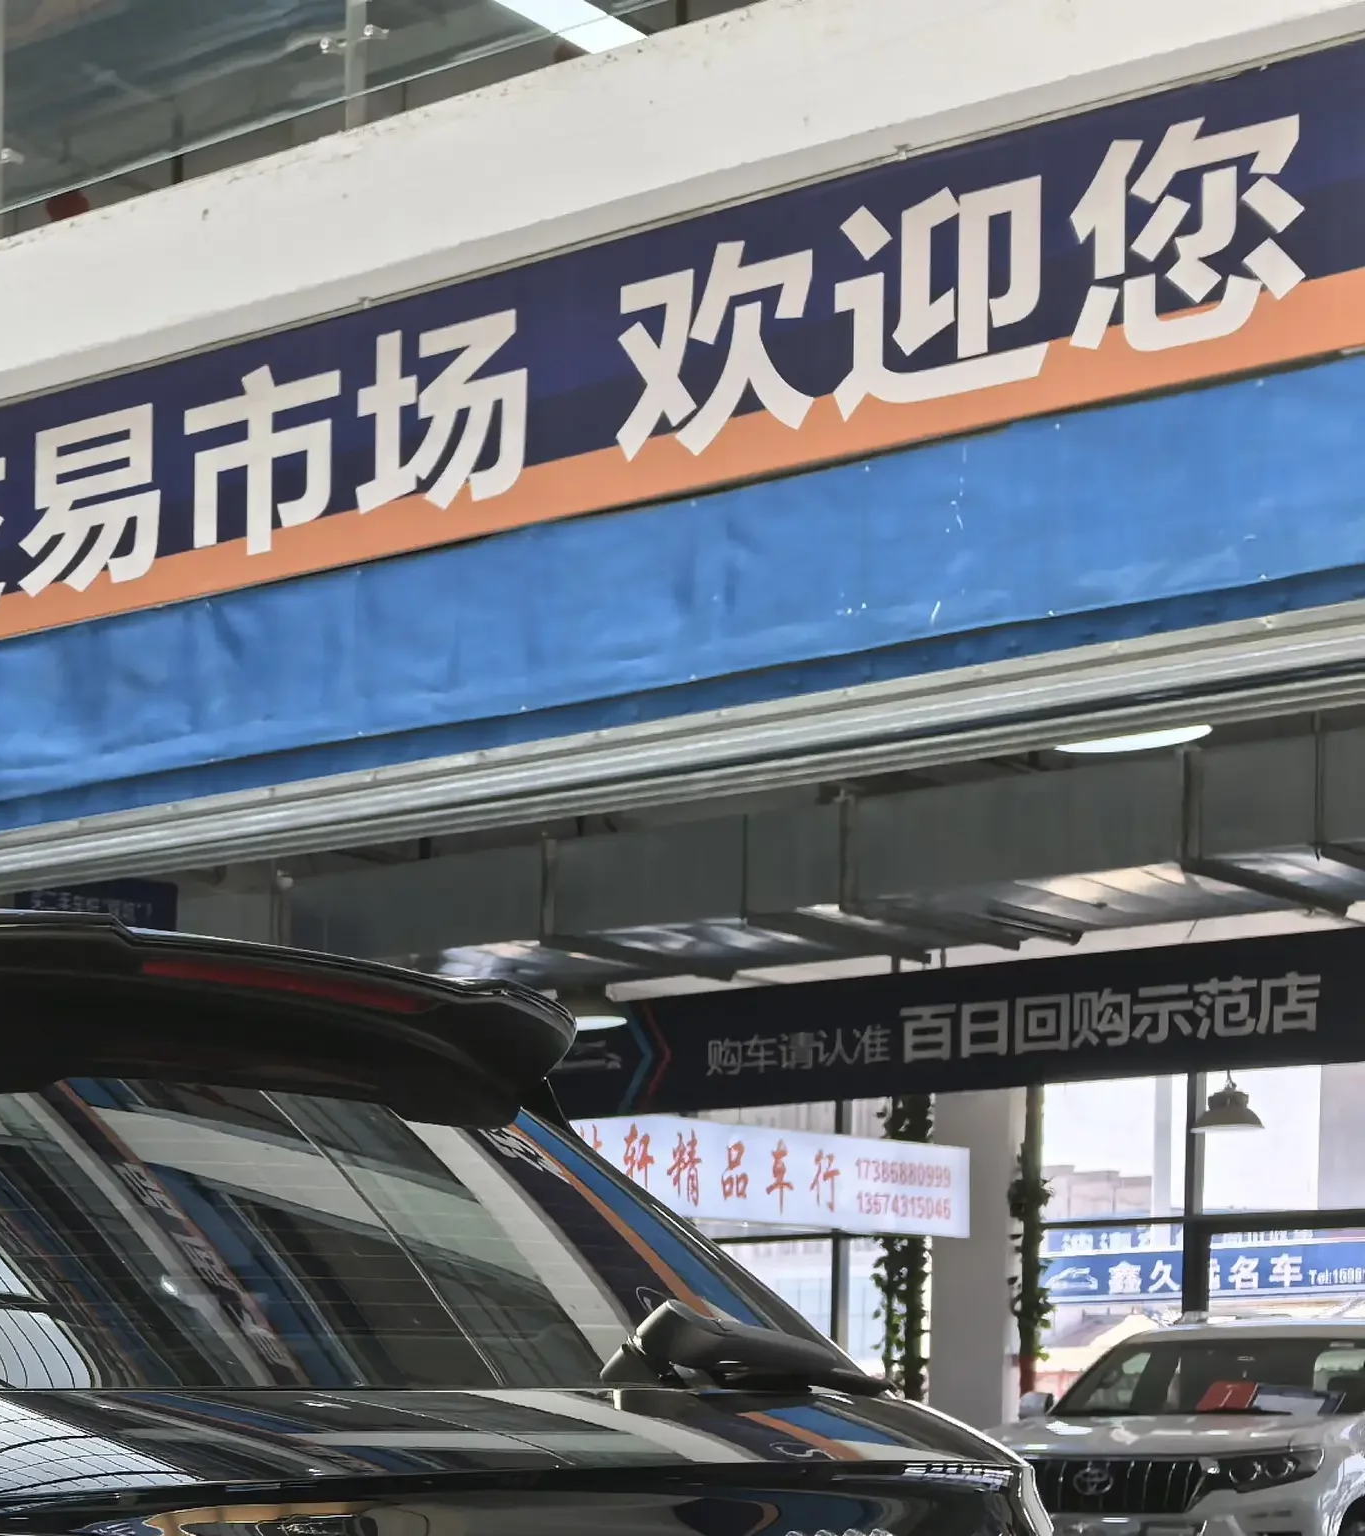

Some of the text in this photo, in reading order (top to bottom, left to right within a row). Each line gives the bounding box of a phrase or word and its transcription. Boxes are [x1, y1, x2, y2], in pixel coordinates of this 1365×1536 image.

[616, 114, 1305, 462] 欢迎您
[707, 1024, 891, 1076] 购车请认准
[900, 972, 1322, 1064] 百日回购示范店
